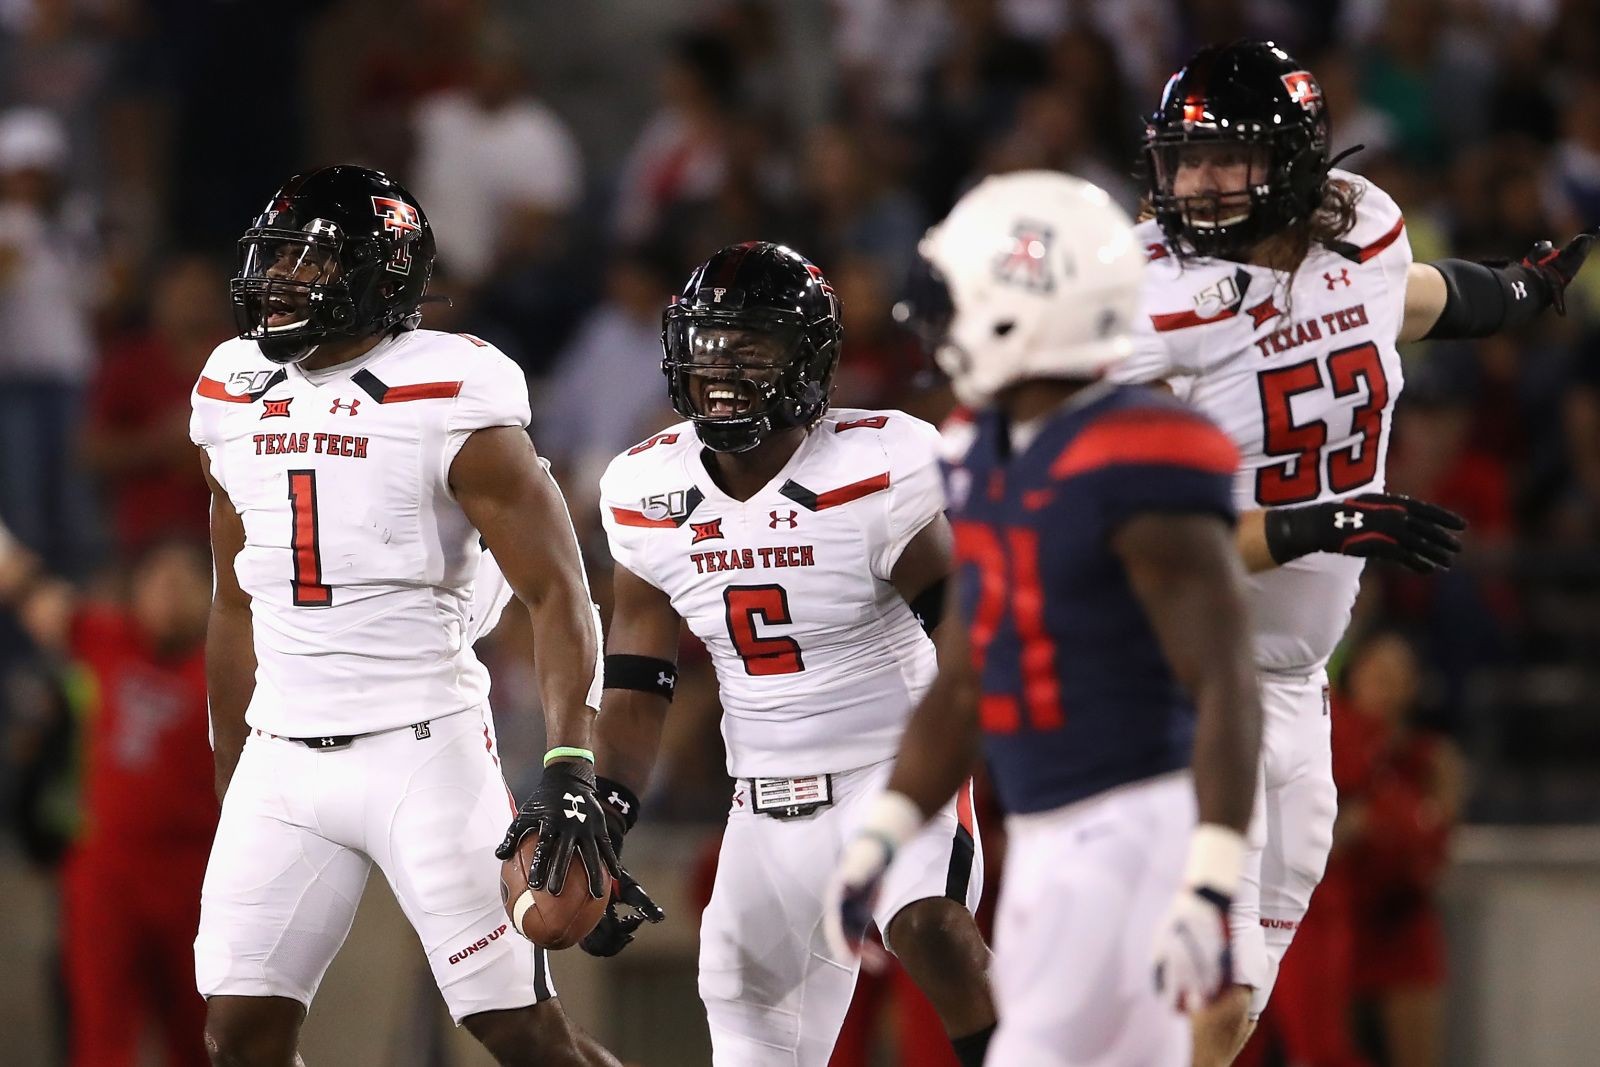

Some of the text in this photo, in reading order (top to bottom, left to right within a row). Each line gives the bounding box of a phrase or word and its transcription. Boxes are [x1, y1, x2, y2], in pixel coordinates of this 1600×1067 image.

[1255, 320, 1322, 357] TEXAS
[1321, 303, 1369, 335] TECH
[228, 370, 273, 392] 150
[253, 433, 369, 459] TEXAS TECH
[1256, 341, 1388, 505] 53
[640, 489, 686, 520] 150
[287, 469, 333, 607] 1
[690, 545, 815, 574] TEXAS TECH
[723, 583, 805, 677] 6
[950, 522, 1065, 734] 21
[448, 924, 507, 965] GUNS UP
